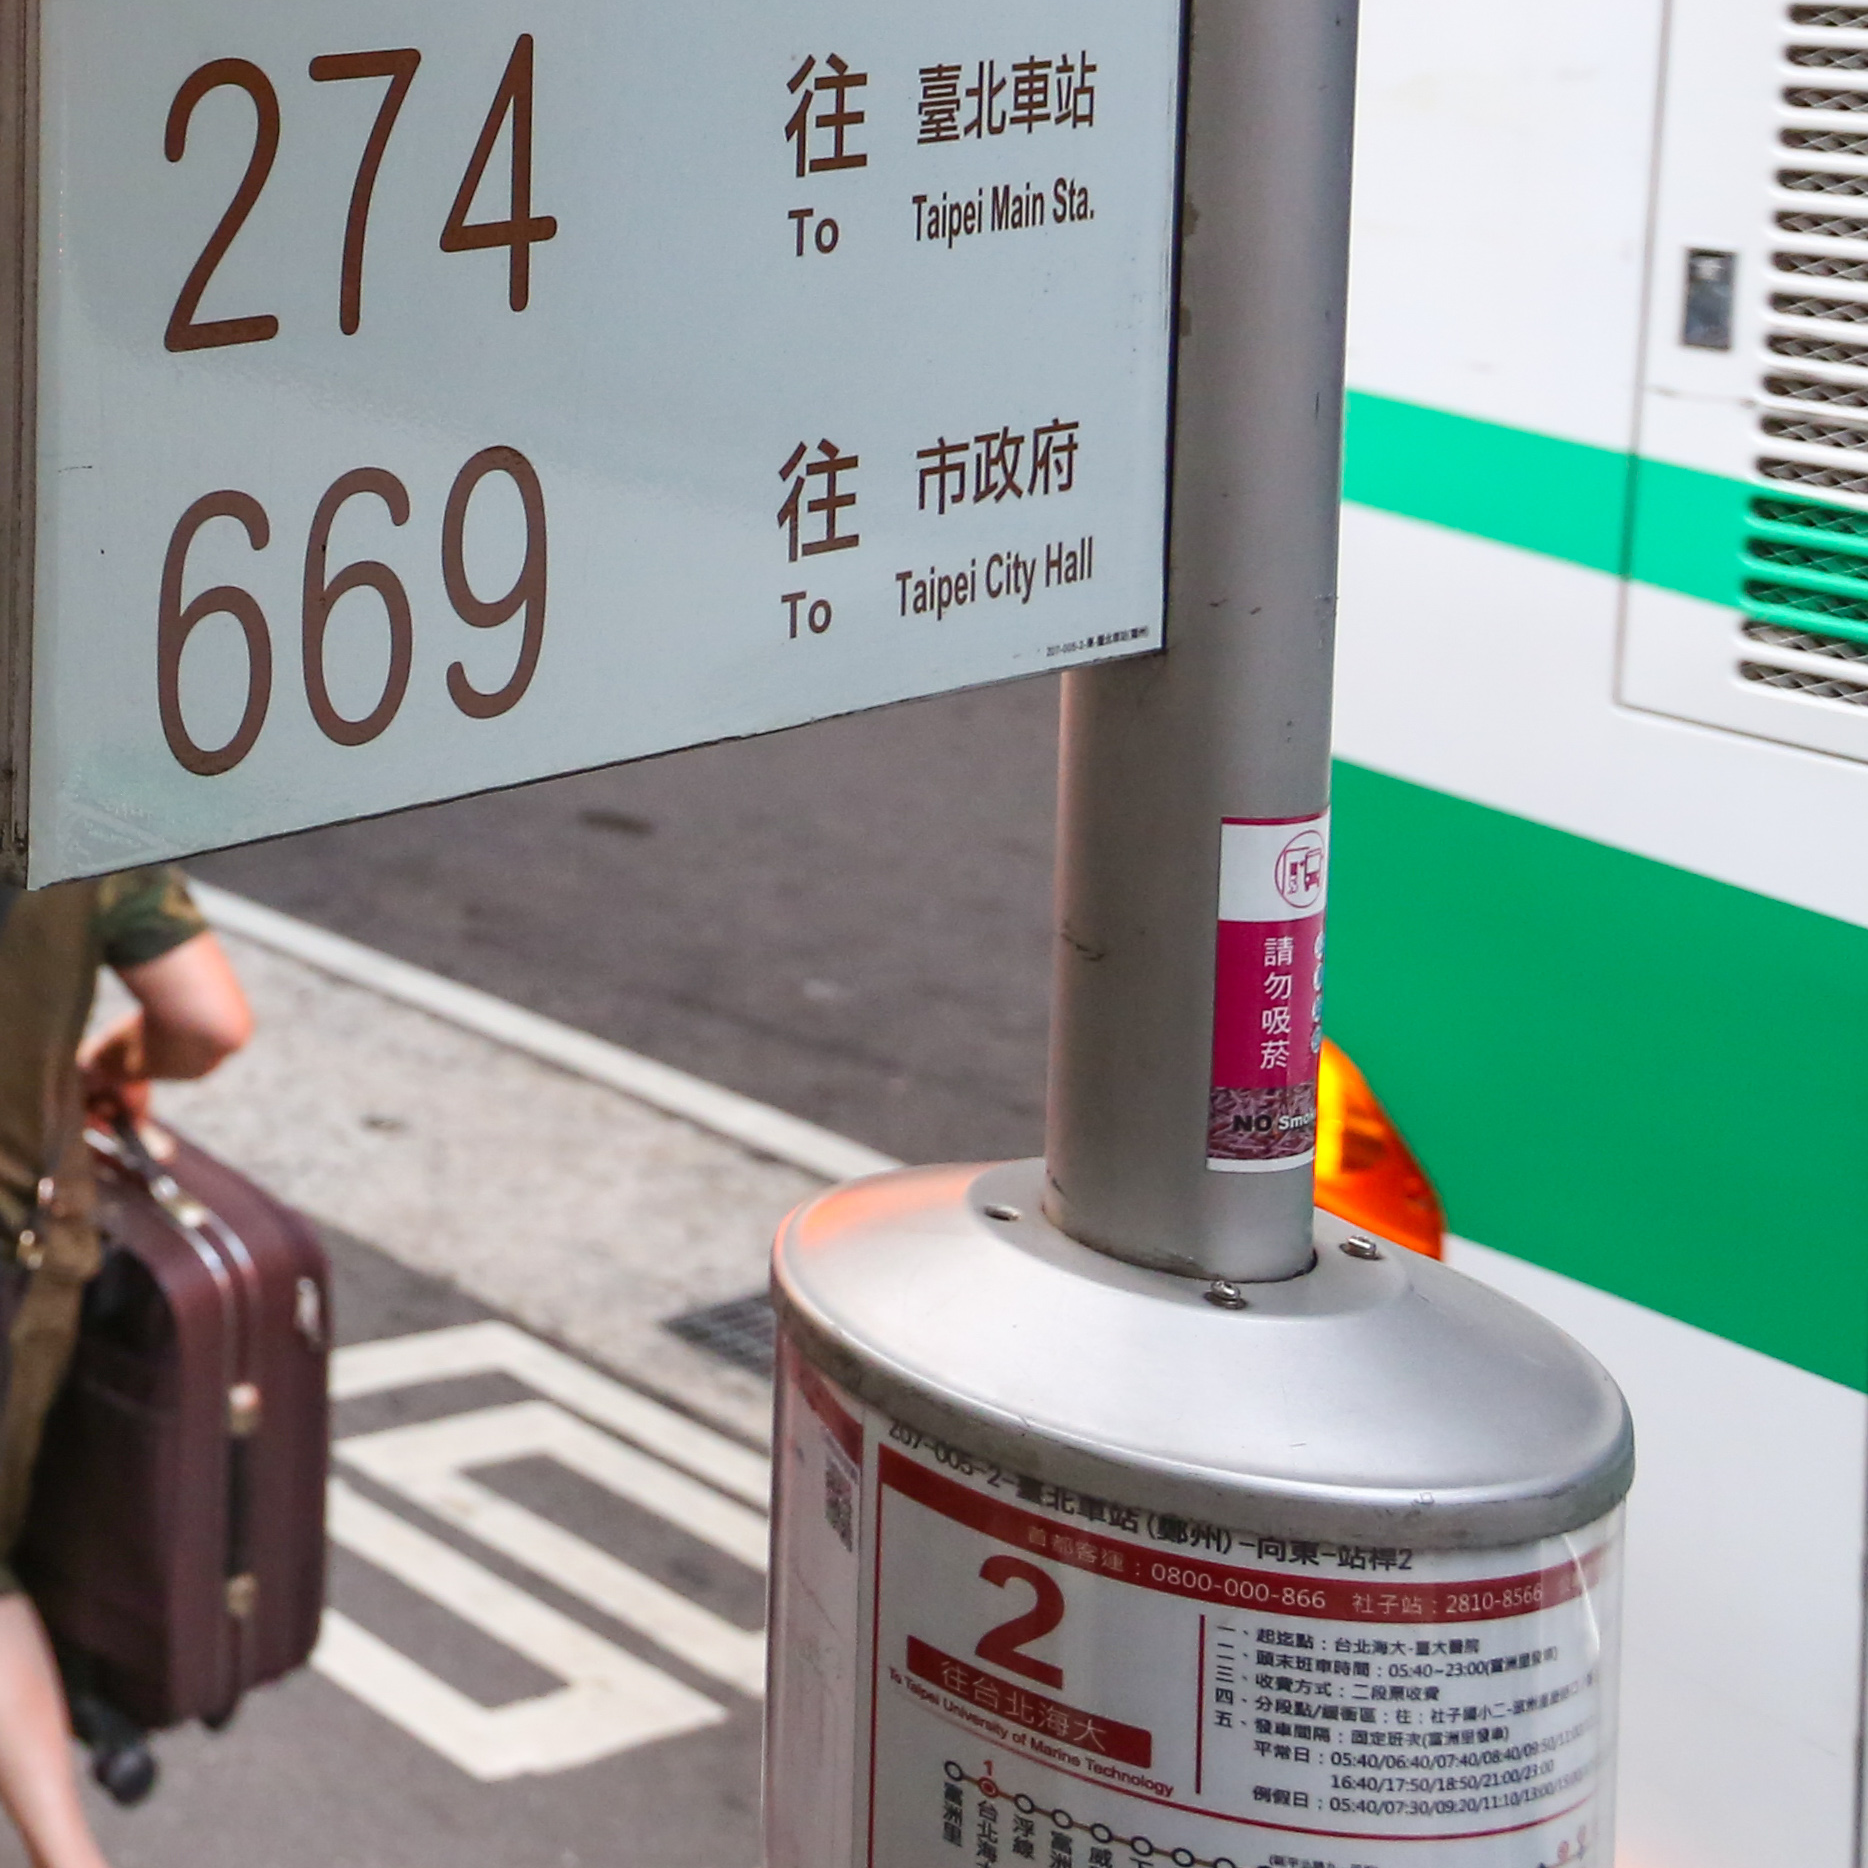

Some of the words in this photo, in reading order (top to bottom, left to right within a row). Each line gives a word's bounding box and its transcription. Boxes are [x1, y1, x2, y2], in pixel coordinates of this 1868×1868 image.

[785, 53, 868, 178] 往
[917, 50, 1098, 145] 臺北車站
[164, 33, 557, 353] 274
[788, 208, 840, 257] To
[912, 188, 984, 248] Taipei
[990, 182, 1046, 233] Main
[1053, 177, 1095, 226] Sta.
[777, 438, 860, 563] 往
[917, 418, 1080, 515] 市政府
[157, 445, 547, 777] 669
[781, 591, 832, 639] To
[896, 558, 976, 622] Taipei
[986, 551, 1036, 605] City
[1046, 536, 1093, 586] Hall
[1260, 936, 1294, 1070] 請勿吸菸
[1232, 1114, 1273, 1132] NO
[975, 1554, 1064, 1691] 2
[888, 1666, 903, 1685] To
[904, 1671, 941, 1708] Taipei
[942, 1697, 1009, 1740] University
[1012, 1731, 1028, 1747] of
[1029, 1737, 1081, 1768] Marine
[1084, 1755, 1175, 1798] Technology
[940, 1659, 1108, 1753] 往台北海大
